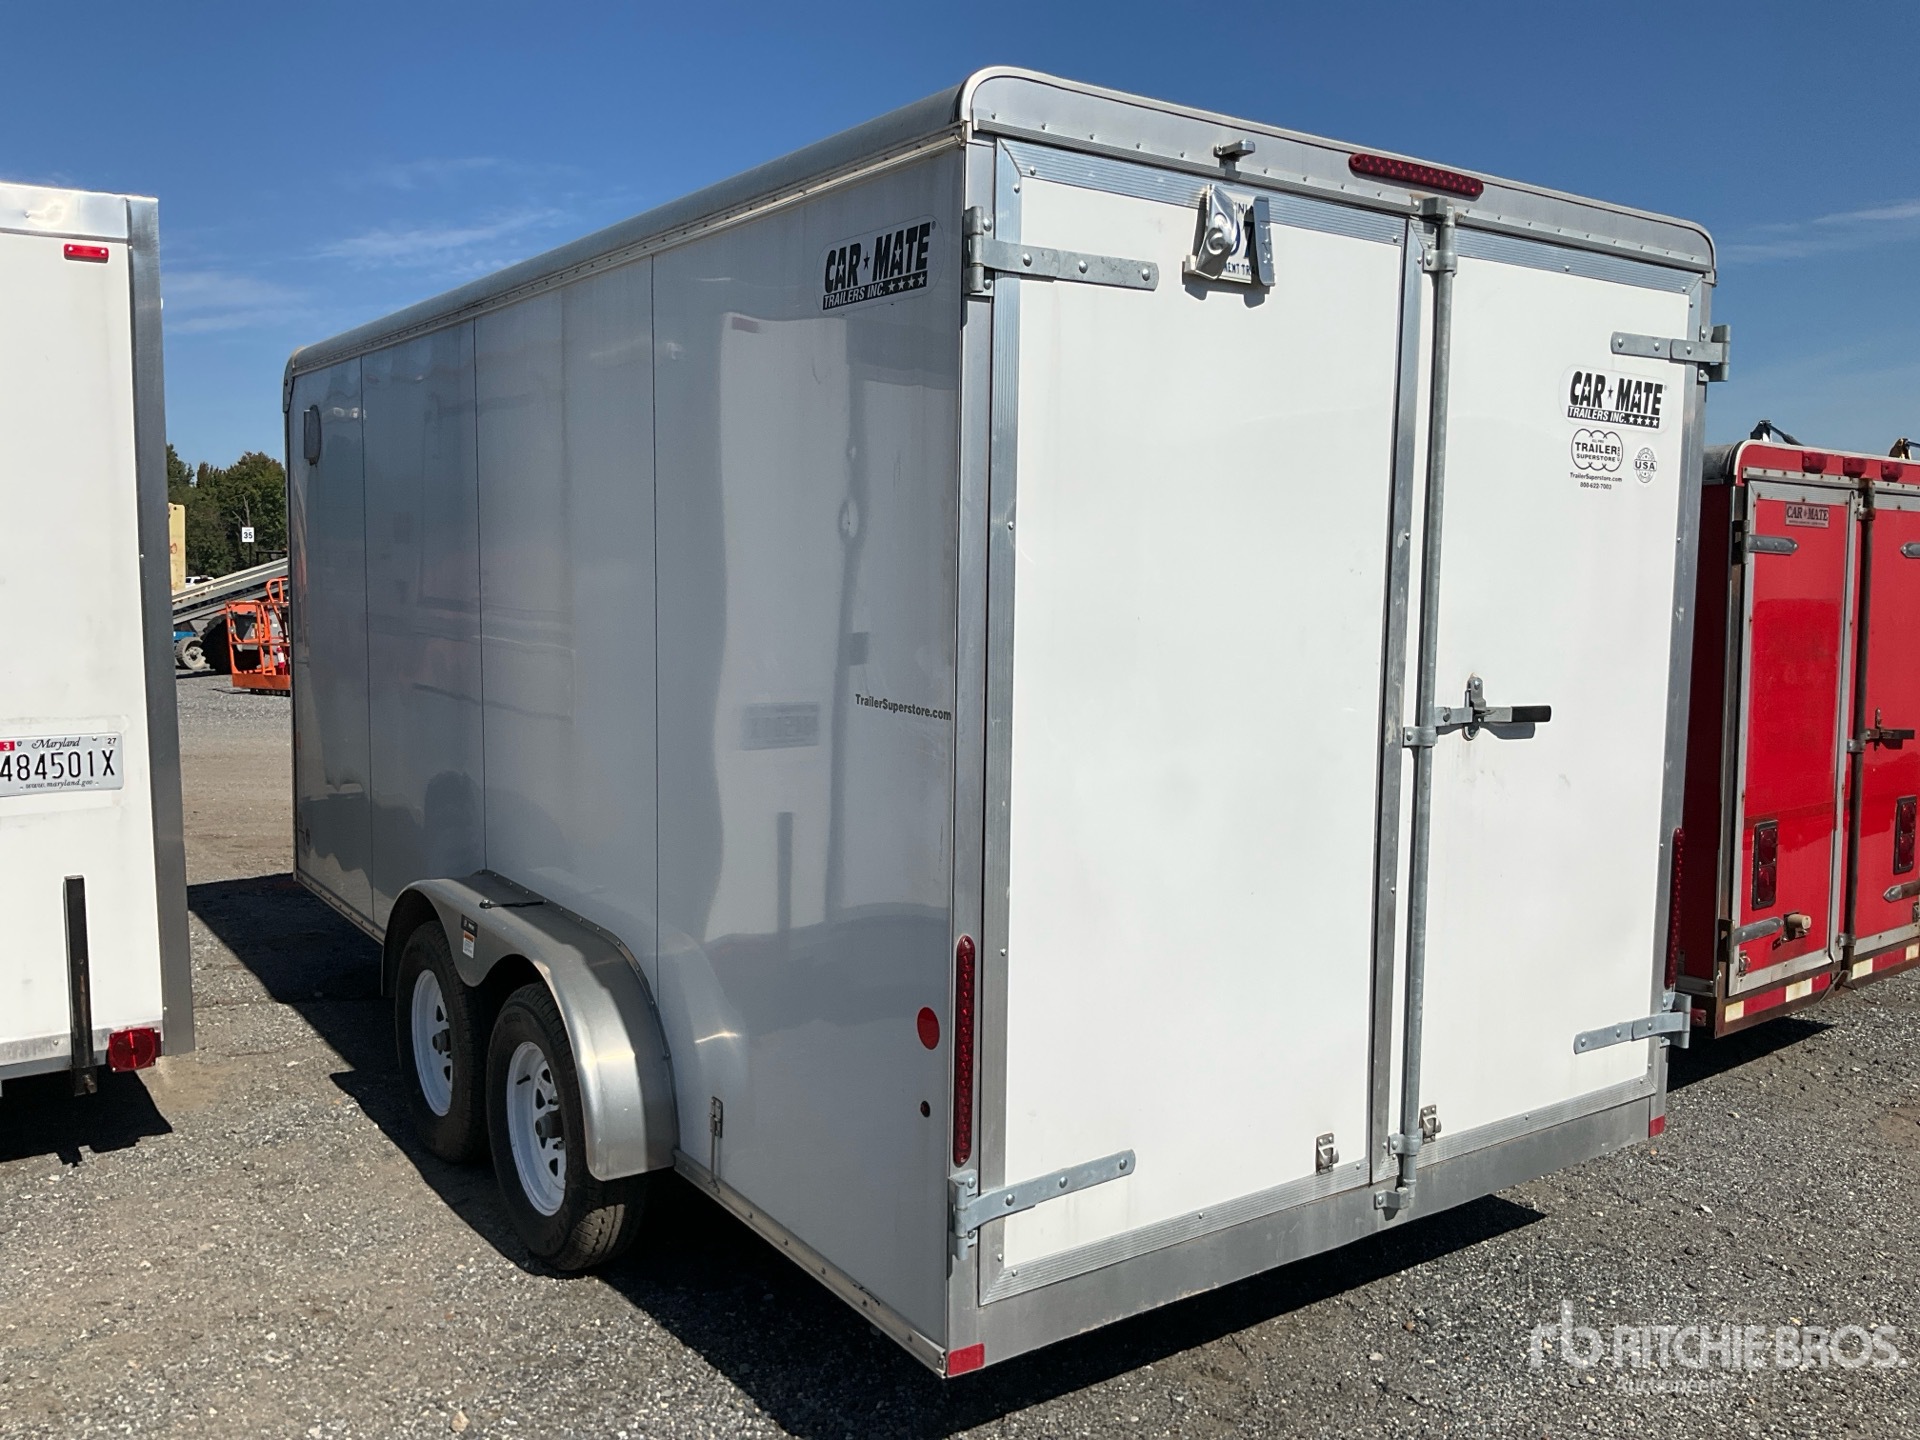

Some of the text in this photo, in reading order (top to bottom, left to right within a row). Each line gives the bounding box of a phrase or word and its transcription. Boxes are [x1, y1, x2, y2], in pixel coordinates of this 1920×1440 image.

[824, 222, 931, 293] CAR MATE
[824, 282, 886, 309] TRAILERS INC.
[1570, 371, 1663, 416] CAR MATE
[1568, 406, 1627, 424] TRAILERS INC.
[1575, 441, 1617, 455] TRAILER
[1576, 453, 1616, 462] SUPERSTORE
[1635, 460, 1655, 470] USA
[1786, 506, 1828, 521] CAR MATE
[243, 531, 253, 539] 35
[855, 693, 952, 720] TrailerSuperstore.com
[31, 737, 81, 750] Maryland
[107, 737, 117, 745] 27
[0, 749, 115, 782] 484501X
[25, 780, 93, 789] www.maryland.gov
